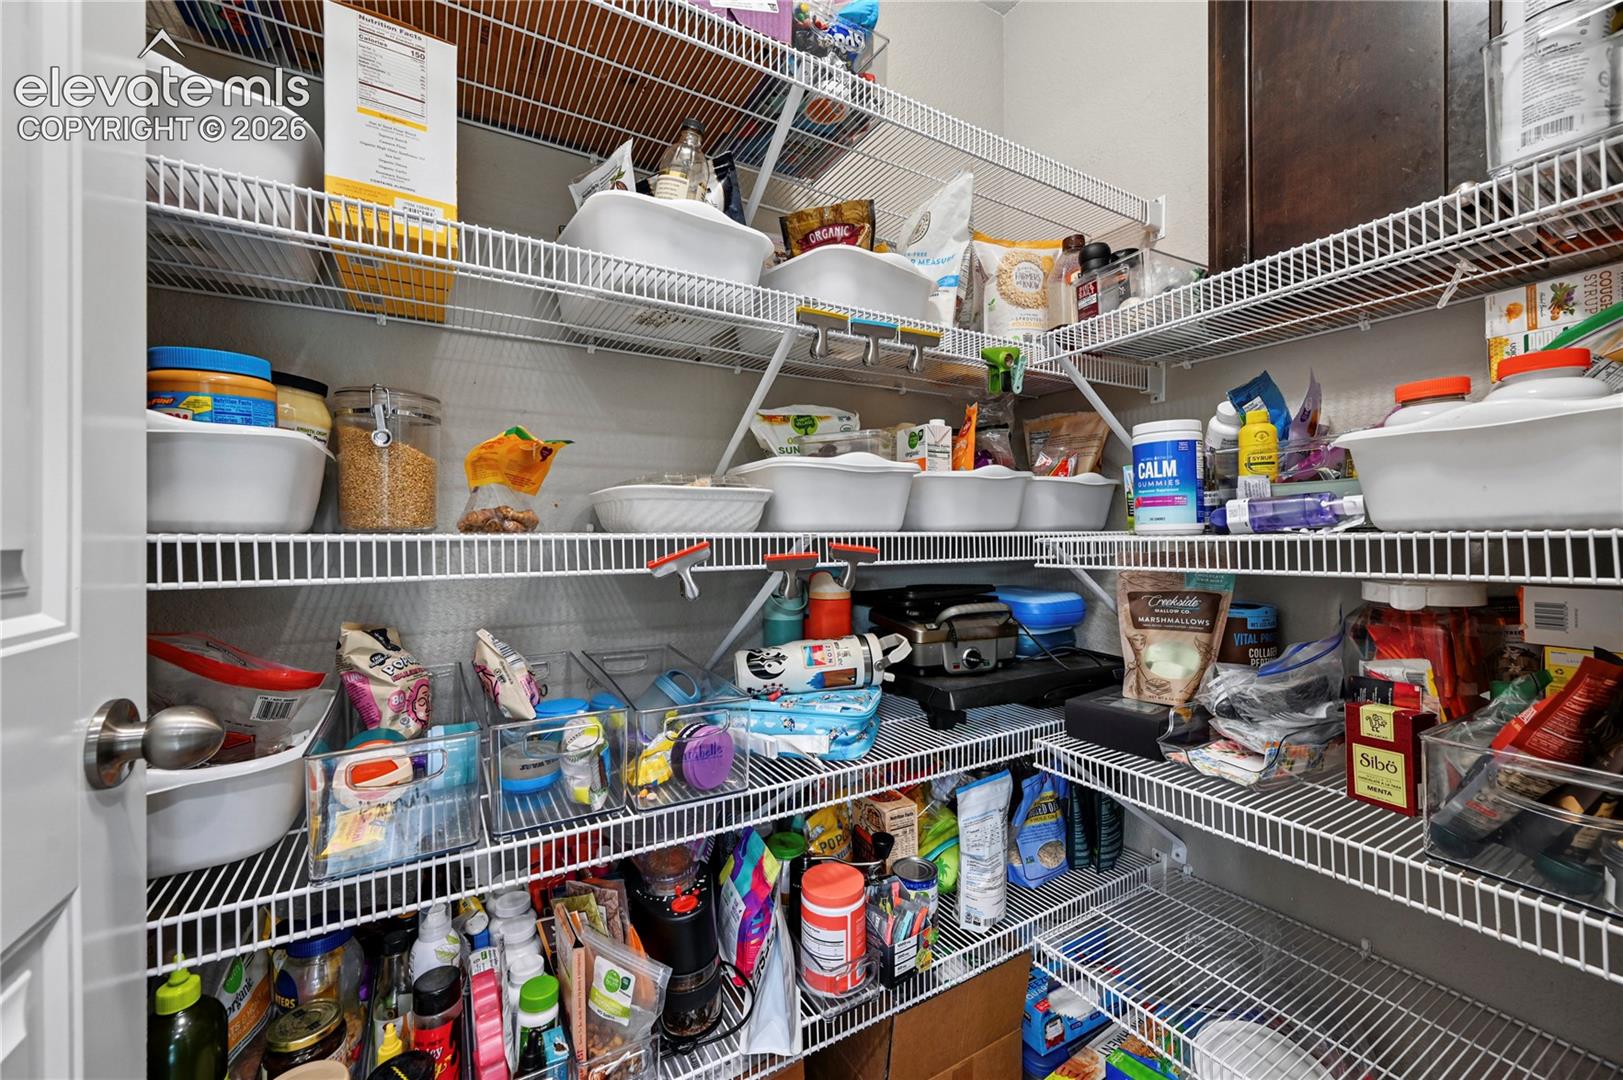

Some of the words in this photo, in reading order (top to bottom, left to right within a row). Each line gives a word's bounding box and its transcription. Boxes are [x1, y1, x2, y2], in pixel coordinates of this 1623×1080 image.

[359, 14, 397, 32] Nutrition
[399, 28, 422, 41] Facts
[359, 34, 388, 47] Calories
[411, 50, 426, 60] 150
[809, 225, 849, 244] ORGANIC
[1584, 273, 1598, 314] SYRUP
[779, 446, 801, 454] SUN
[1138, 459, 1177, 480] CALM
[1137, 479, 1181, 488] GUMMIES
[1142, 594, 1203, 609] Creekside
[1138, 616, 1211, 627] MARSHMALLOWS
[1233, 632, 1258, 647] VITAL
[825, 644, 833, 663] ZION
[1359, 753, 1398, 775] Sibö
[1366, 784, 1393, 797] MENTA
